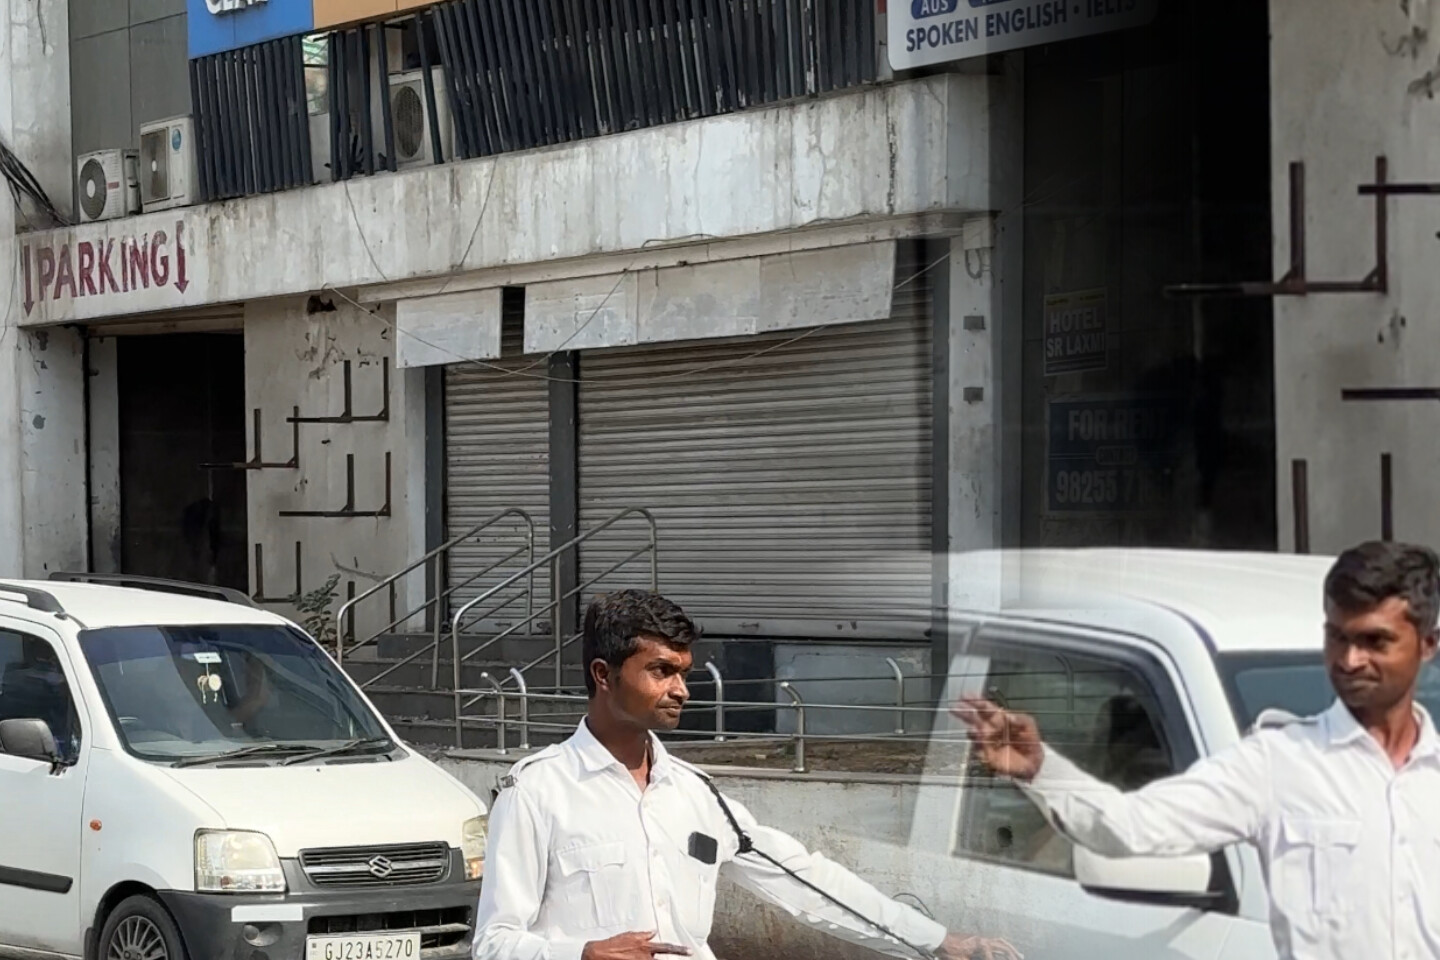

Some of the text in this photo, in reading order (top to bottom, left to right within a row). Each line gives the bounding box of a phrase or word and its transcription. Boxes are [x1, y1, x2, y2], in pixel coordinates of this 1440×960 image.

[905, 18, 979, 52] SPOKEN
[985, 8, 1067, 38] ENGLISH
[36, 229, 170, 302] PARKING
[1050, 306, 1103, 334] HOTEL
[1068, 408, 1109, 441] FOR
